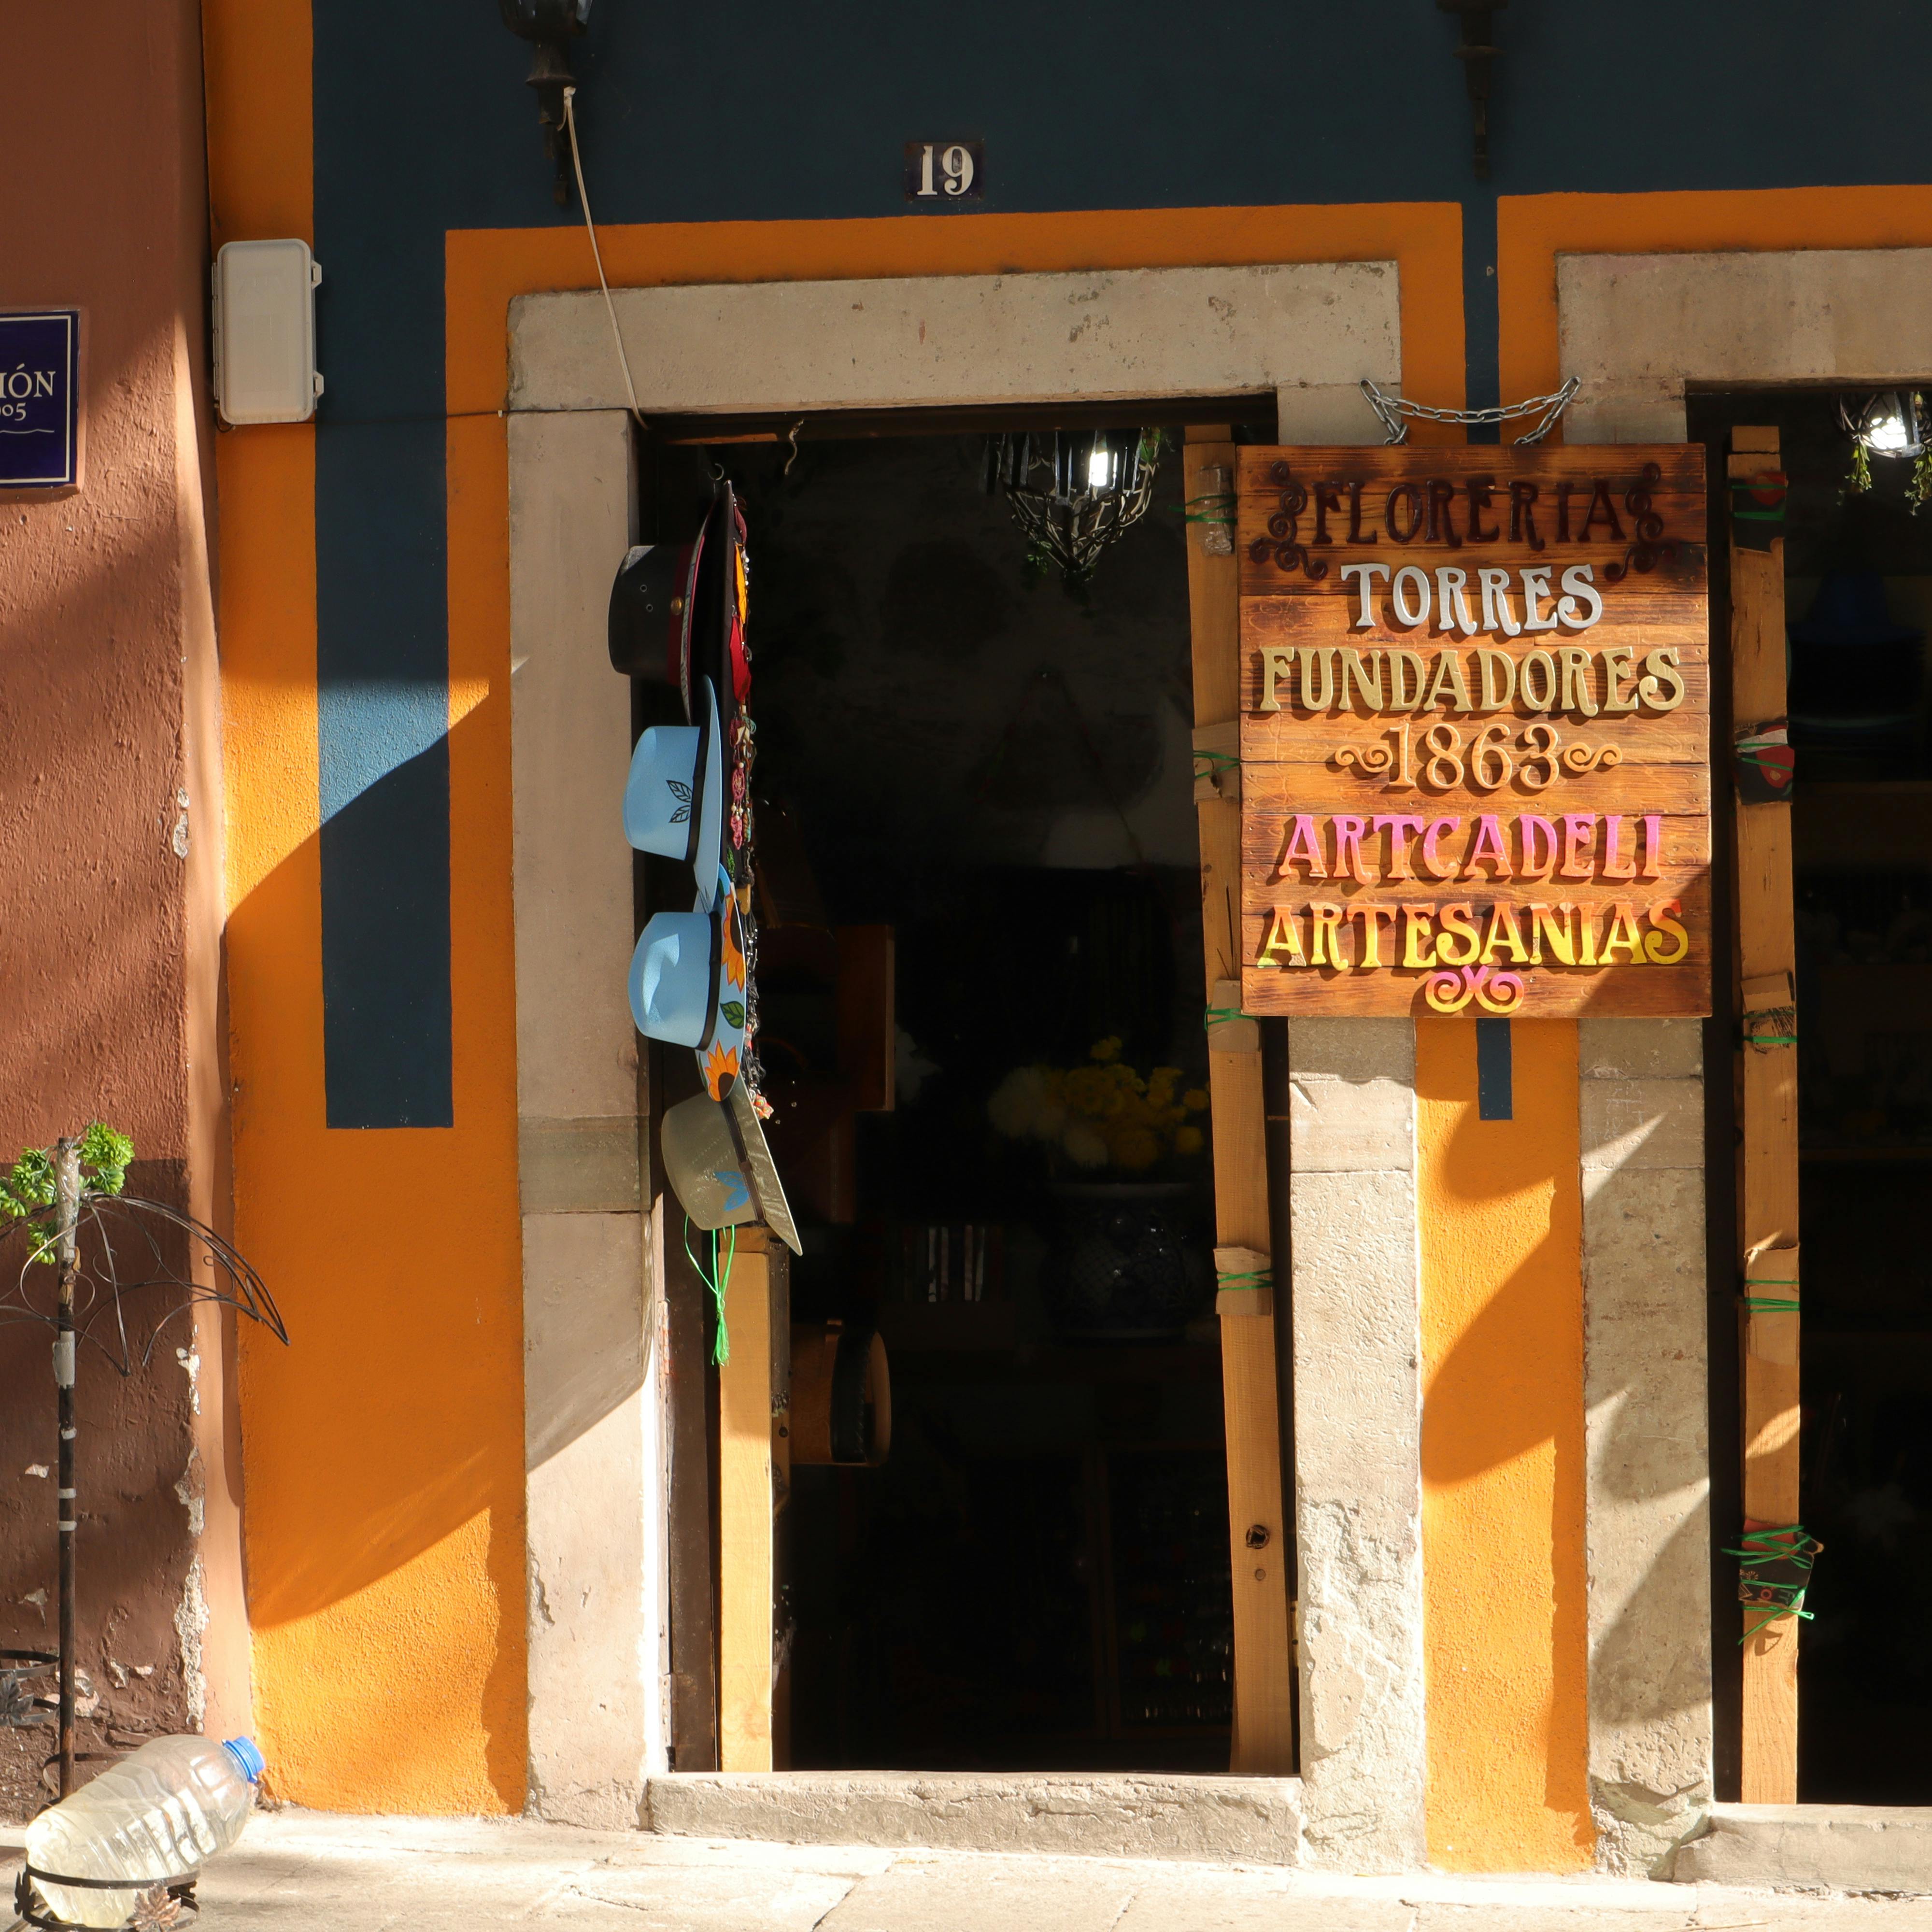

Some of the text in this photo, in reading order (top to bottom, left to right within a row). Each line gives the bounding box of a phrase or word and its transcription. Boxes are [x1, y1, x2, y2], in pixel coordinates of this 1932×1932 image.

[917, 145, 974, 195] 19
[0, 402, 27, 421] 05
[1311, 477, 1627, 552] FLORERIA
[1340, 563, 1603, 637] TORRES
[1259, 646, 1686, 718] FUNDADORES
[1387, 723, 1560, 790] 1863
[1278, 813, 1662, 885] ARTCADELI
[1256, 899, 1689, 972] ARTESANIAS
